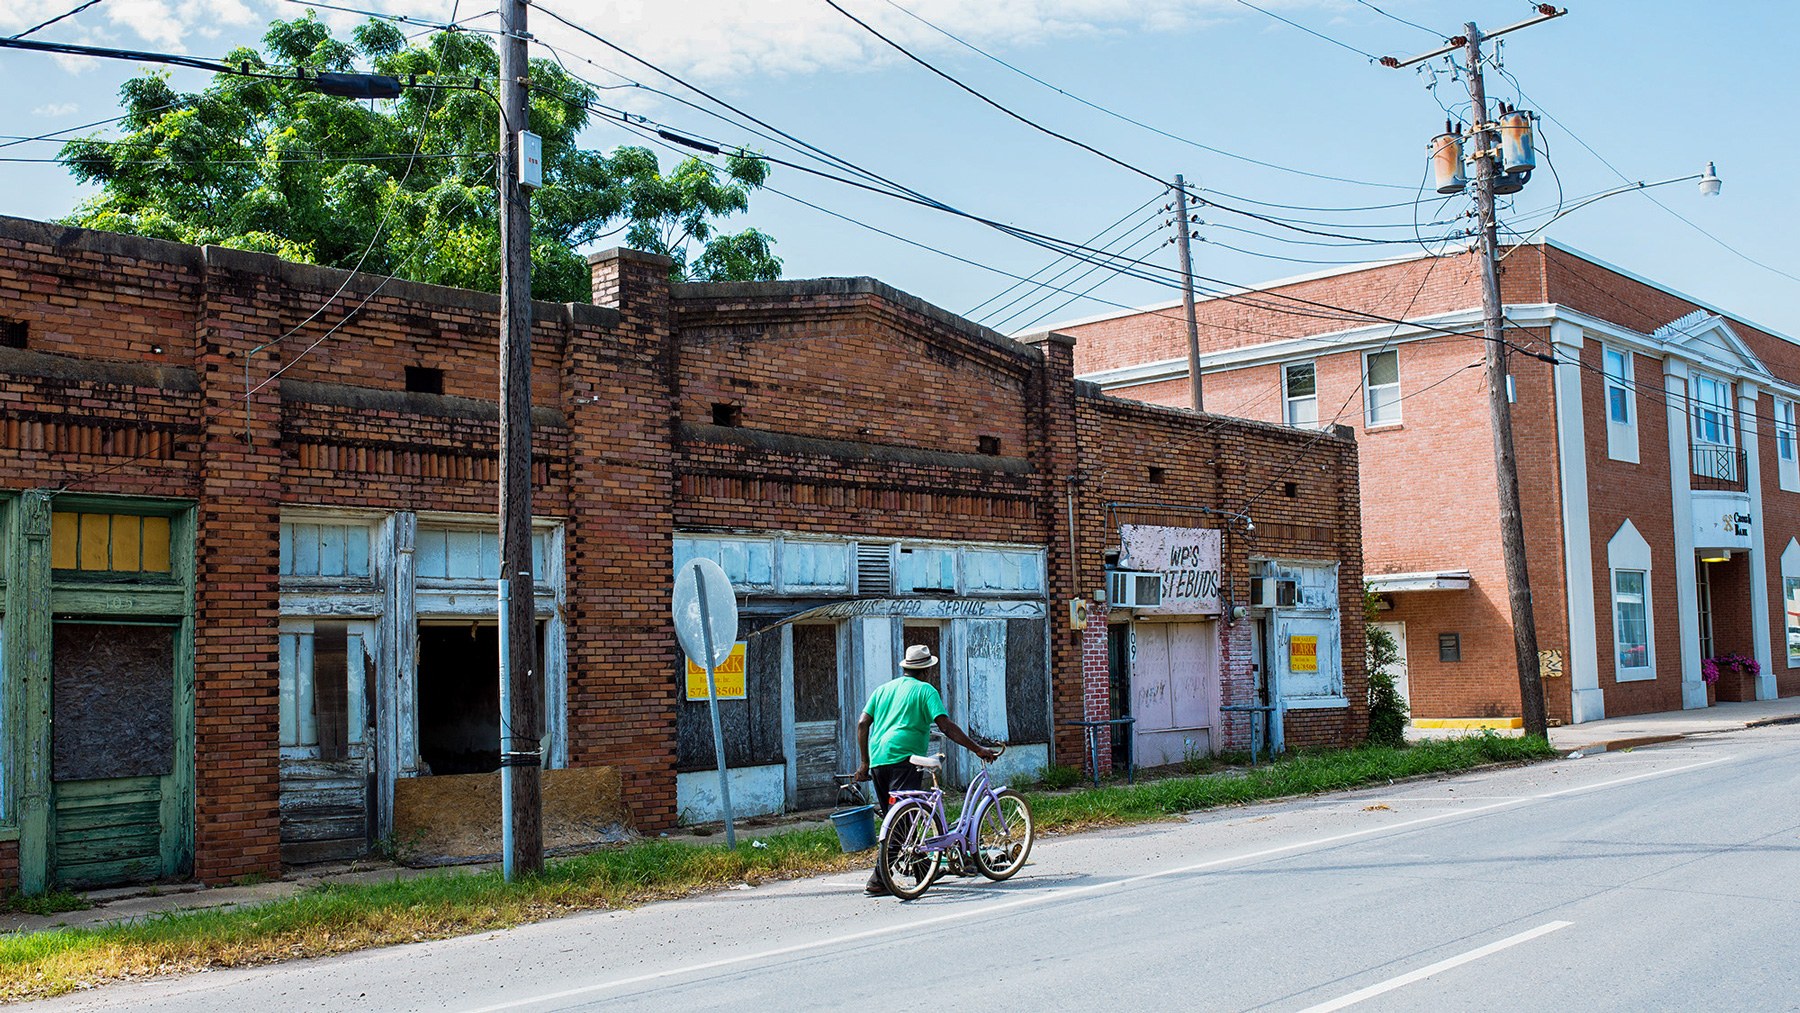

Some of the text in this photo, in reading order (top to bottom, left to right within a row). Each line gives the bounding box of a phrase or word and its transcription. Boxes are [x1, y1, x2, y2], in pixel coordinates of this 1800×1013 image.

[1170, 545, 1199, 567] WP'S
[1161, 570, 1219, 598] STEBUDS
[937, 601, 986, 616] SERVICE
[689, 656, 742, 673] CRK
[690, 687, 742, 697] 5748500
